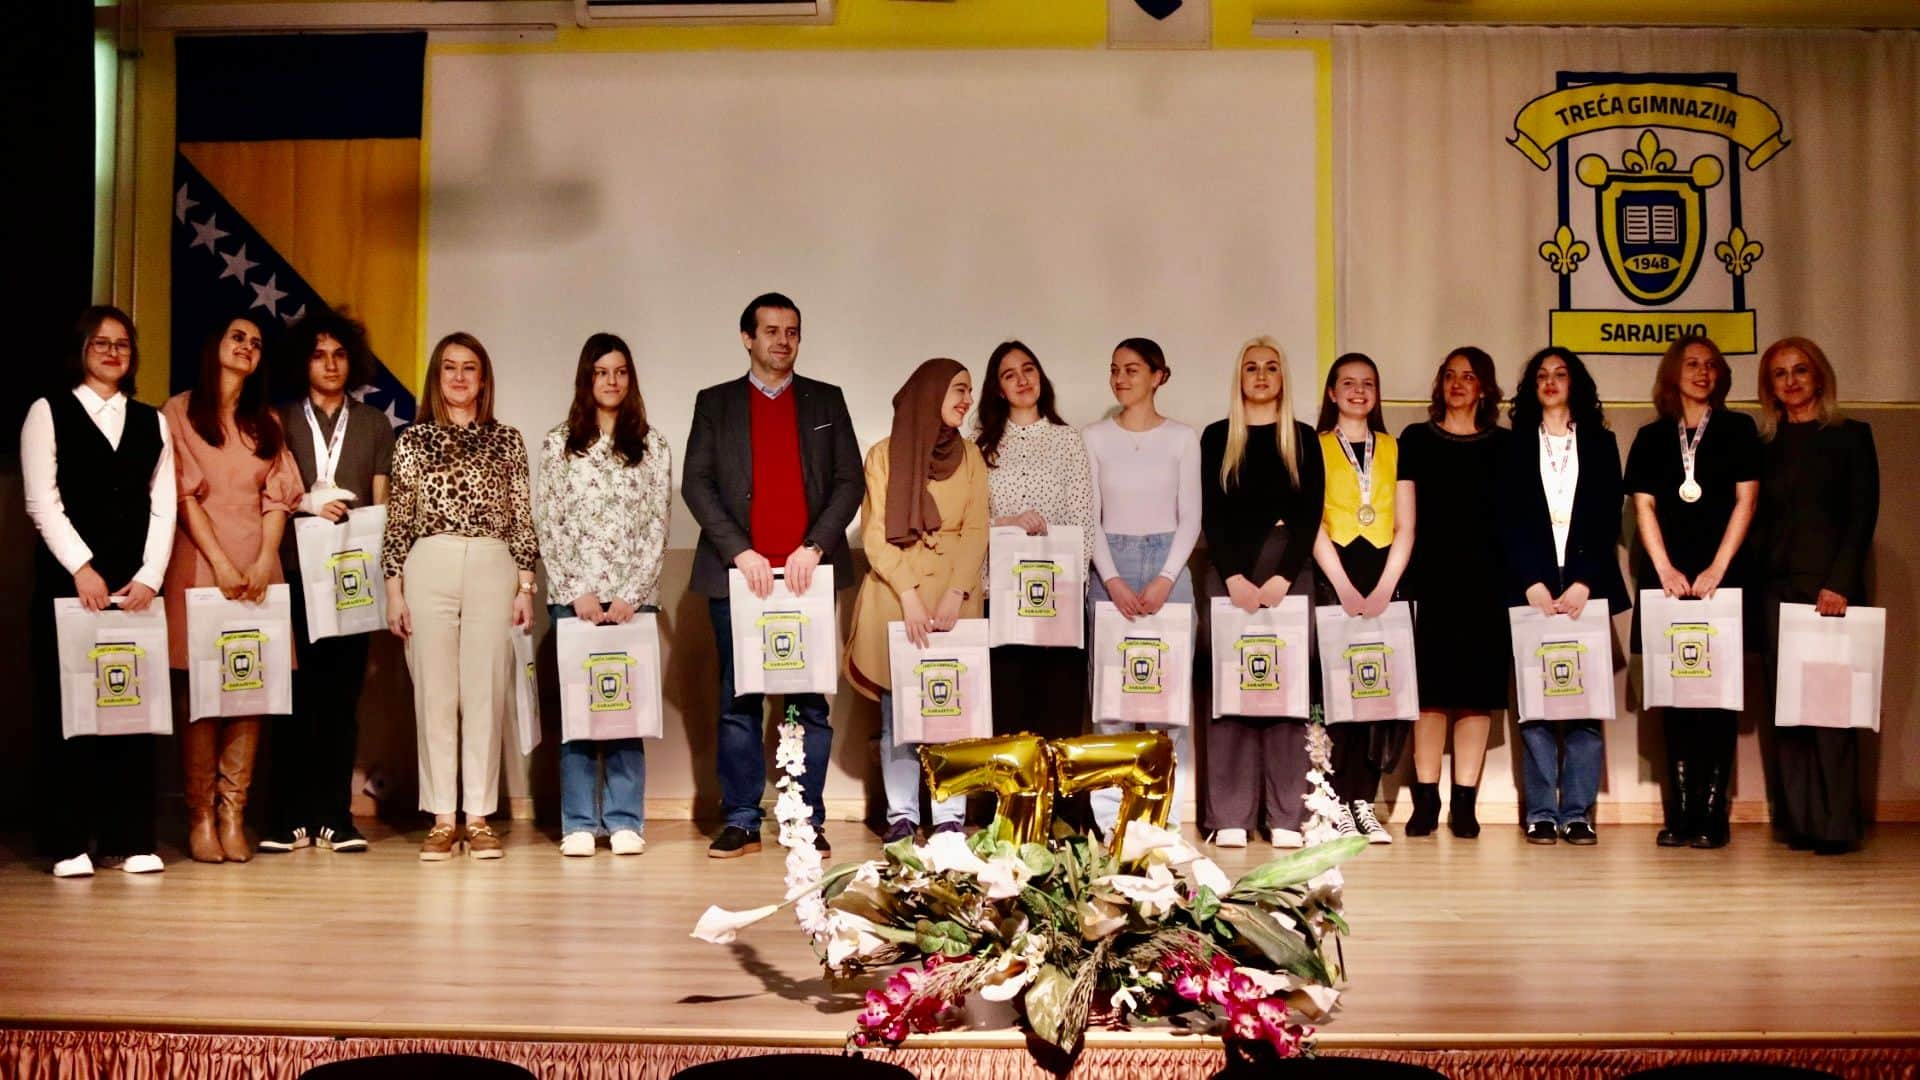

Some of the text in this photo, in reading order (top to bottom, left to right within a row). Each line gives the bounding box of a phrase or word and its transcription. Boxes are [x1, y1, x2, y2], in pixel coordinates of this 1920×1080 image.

[1555, 93, 1737, 128] TREĆA GIMNAZIJA
[1632, 257, 1669, 270] 1948
[1600, 323, 1707, 343] SARAJEVO
